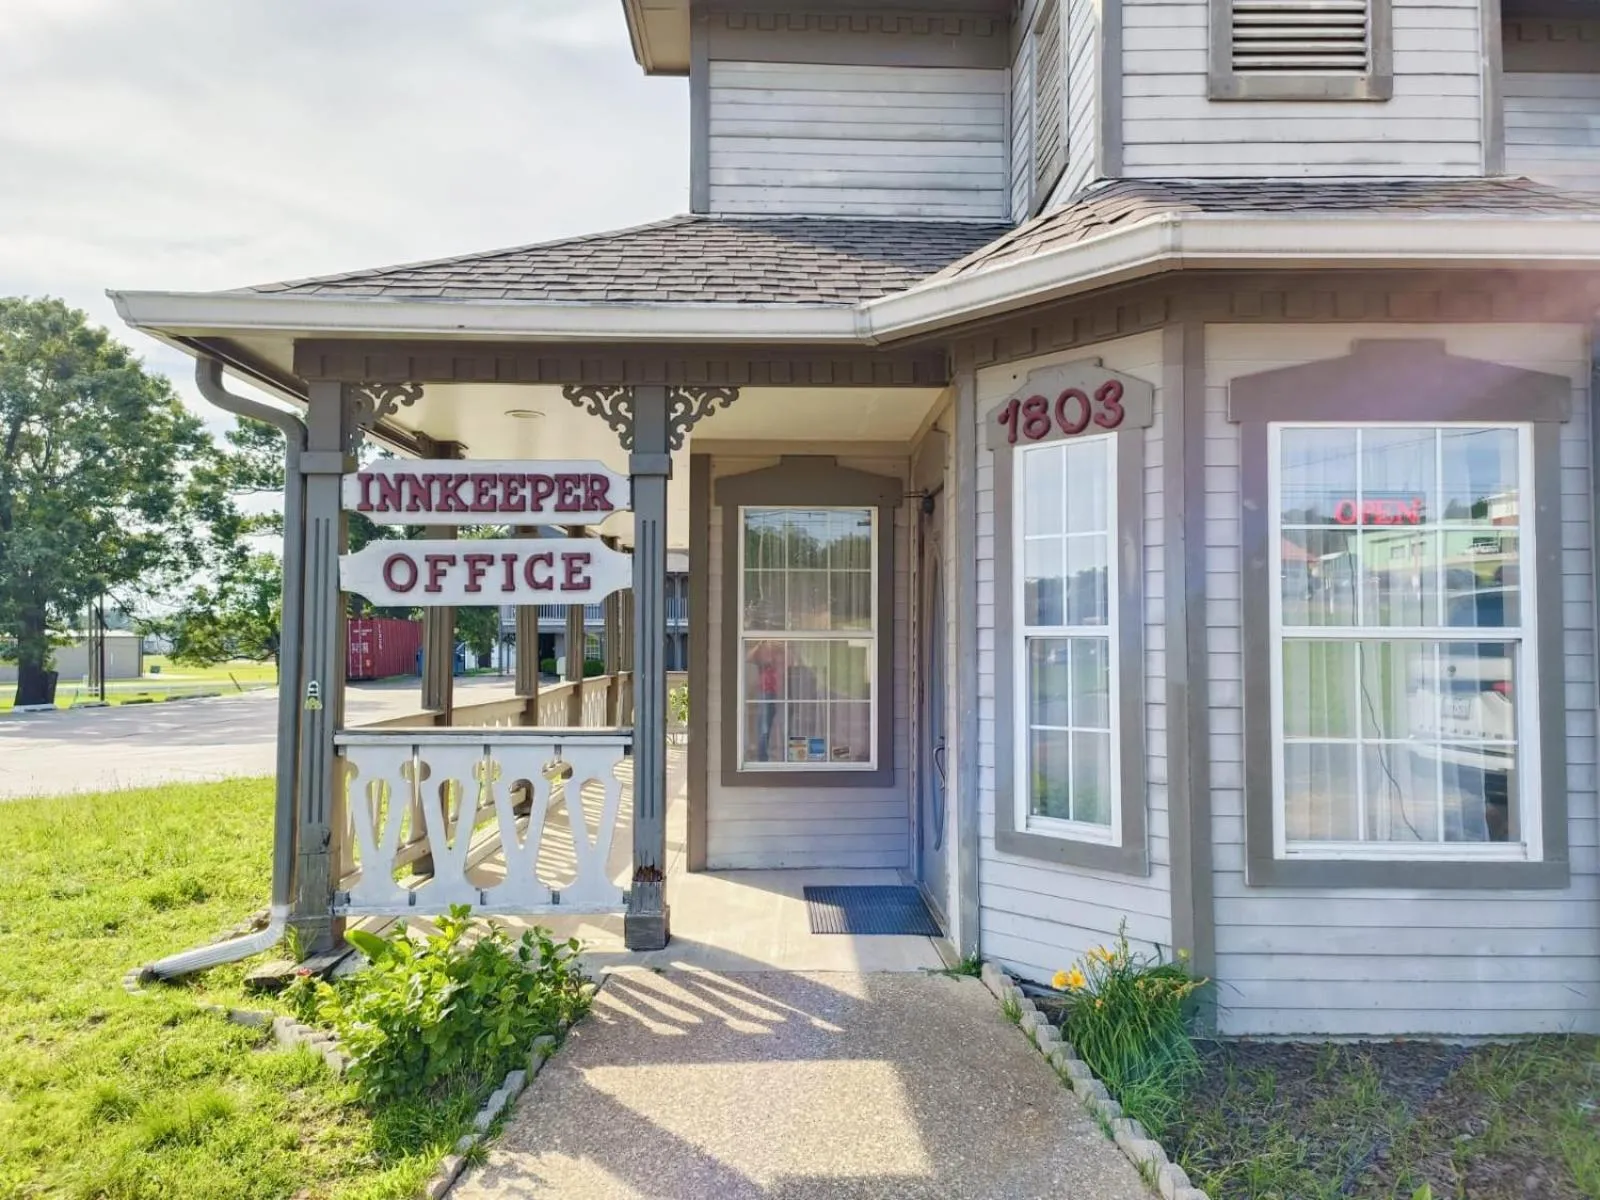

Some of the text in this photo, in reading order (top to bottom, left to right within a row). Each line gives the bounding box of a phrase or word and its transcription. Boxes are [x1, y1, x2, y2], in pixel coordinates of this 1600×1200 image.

[997, 379, 1125, 444] 1803
[356, 472, 615, 513] INNKEEPER
[1333, 498, 1422, 525] OPEN
[382, 551, 592, 593] OFFICE
